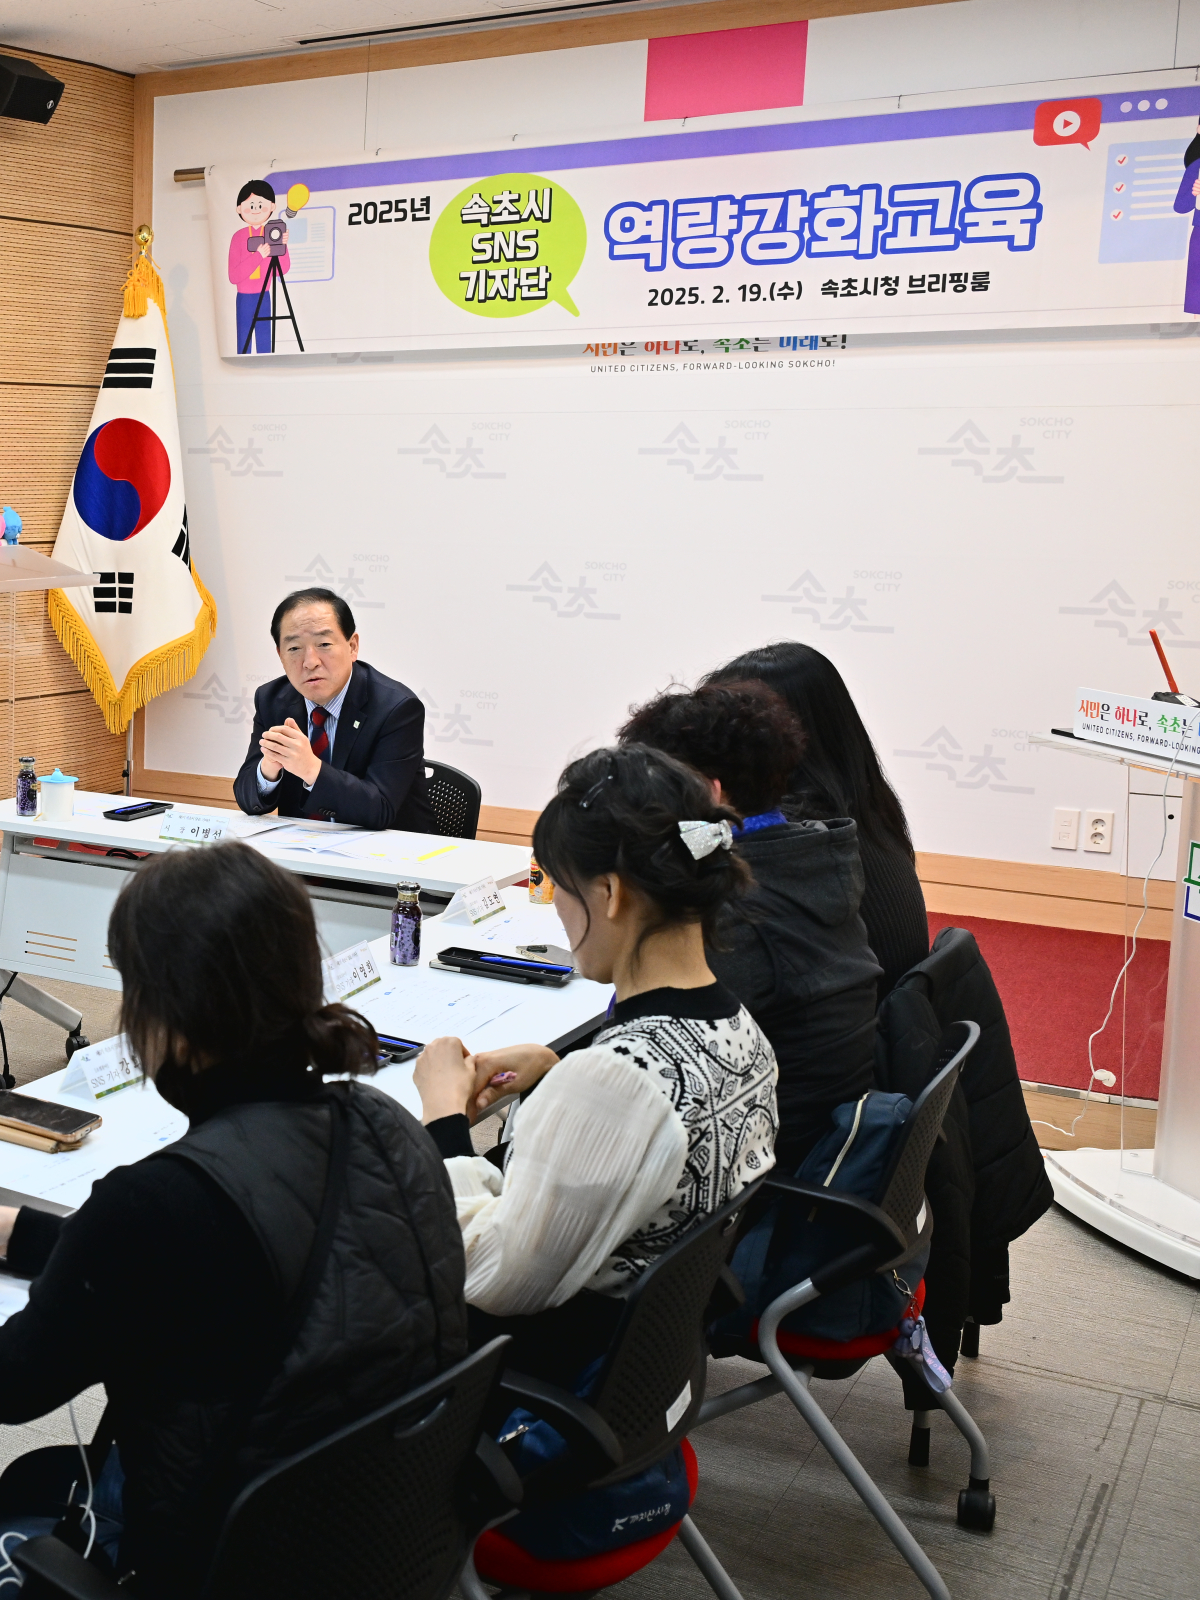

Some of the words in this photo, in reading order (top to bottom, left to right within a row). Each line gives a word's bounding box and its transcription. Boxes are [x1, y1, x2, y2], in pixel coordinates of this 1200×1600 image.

[348, 196, 431, 226] 2025년
[460, 187, 552, 226] 속초시
[604, 172, 1044, 271] 역량강화교육
[471, 229, 539, 264] SNS
[459, 265, 552, 303] 기자단
[647, 287, 705, 307] 2025.
[712, 285, 730, 304] 2.
[738, 280, 803, 303] 19.(수)
[820, 275, 900, 299] 속초시청
[907, 271, 990, 295] 브리핑룸
[590, 364, 626, 373] UNITED
[630, 363, 679, 373] CITIZENS,
[682, 361, 785, 371] FORWARD-LOOKING
[788, 359, 836, 368] SOKCHO!
[1078, 700, 1111, 721] 시민은
[1115, 705, 1151, 731] 하나로,
[1082, 722, 1104, 734] UNITED
[1106, 727, 1135, 742] CITIZENS,
[91, 1075, 105, 1088] SNS
[106, 1069, 120, 1081] 기자
